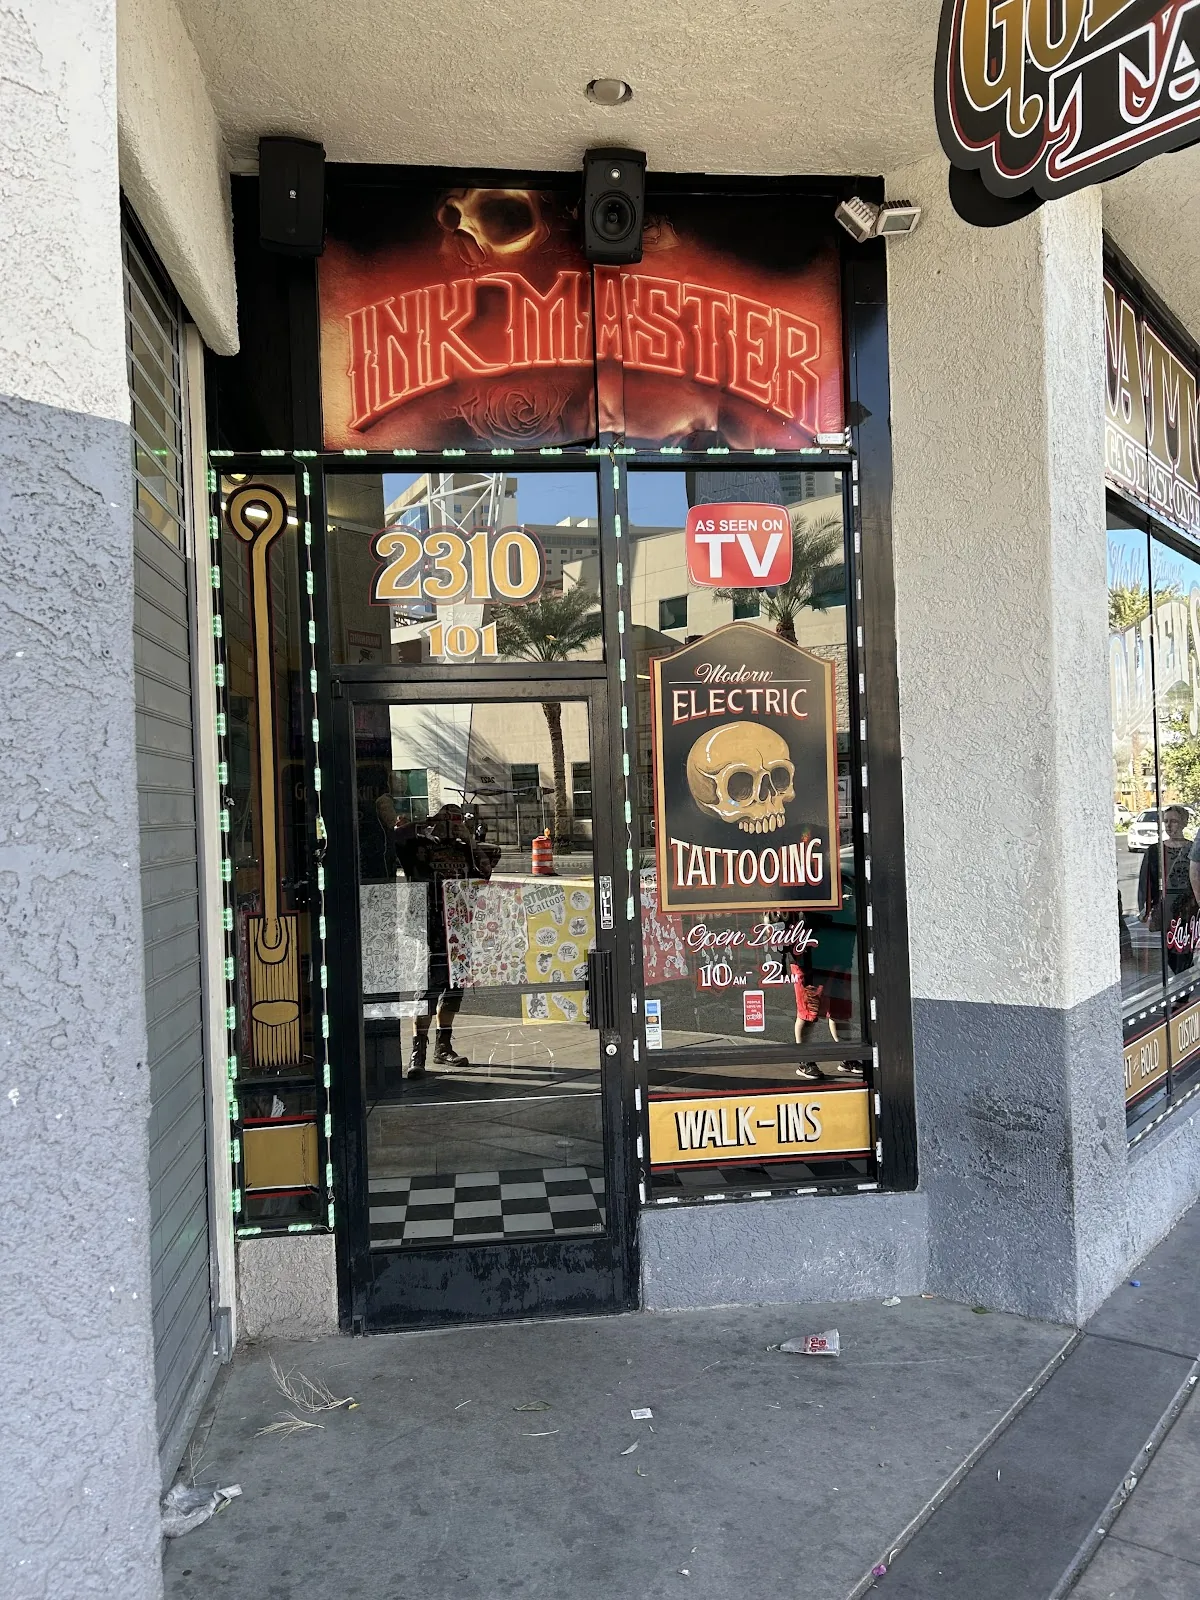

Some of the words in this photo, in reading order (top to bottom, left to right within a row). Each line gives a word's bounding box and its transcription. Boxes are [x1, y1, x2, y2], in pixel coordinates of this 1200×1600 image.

[346, 277, 508, 432] INK
[476, 268, 823, 436] MASTER
[695, 519, 715, 531] AS
[719, 519, 758, 531] SEEN
[761, 519, 782, 531] ON
[373, 530, 541, 600] 2310
[695, 533, 783, 578] TV
[426, 621, 498, 657] 101
[695, 662, 773, 684] Modern
[672, 688, 809, 725] ELECTRIC
[670, 837, 824, 889] TATTOOING
[602, 881, 611, 917] PULL
[687, 923, 746, 953] Open
[748, 920, 819, 954] Daily
[1140, 1038, 1160, 1079] BOLD
[675, 1101, 823, 1150] WALK-INS
